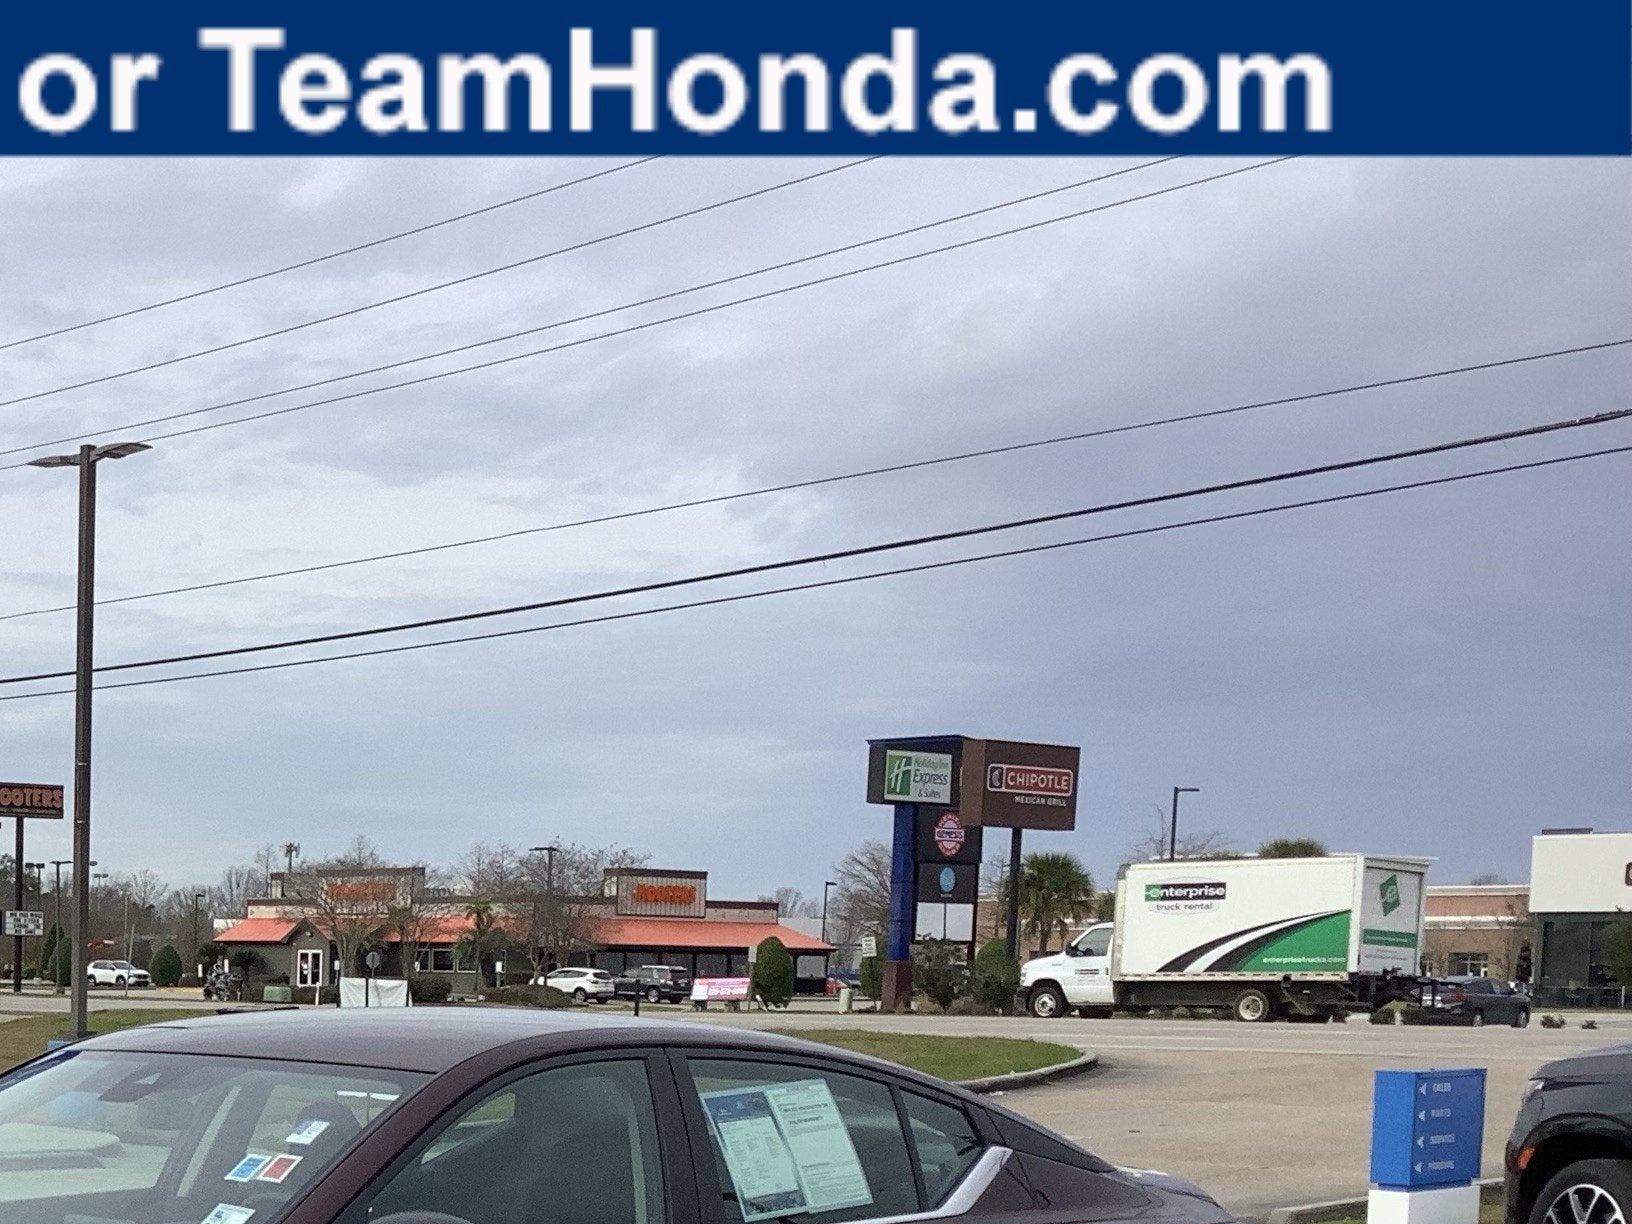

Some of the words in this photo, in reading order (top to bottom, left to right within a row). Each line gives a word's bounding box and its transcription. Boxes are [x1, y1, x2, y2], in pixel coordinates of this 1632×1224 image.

[913, 769, 948, 785] Express
[1007, 771, 1069, 790] CHIPOTLE
[1014, 796, 1045, 805] MEXICAN
[1148, 885, 1226, 899] enterprise
[1156, 902, 1180, 911] truck
[1184, 901, 1214, 910] rental
